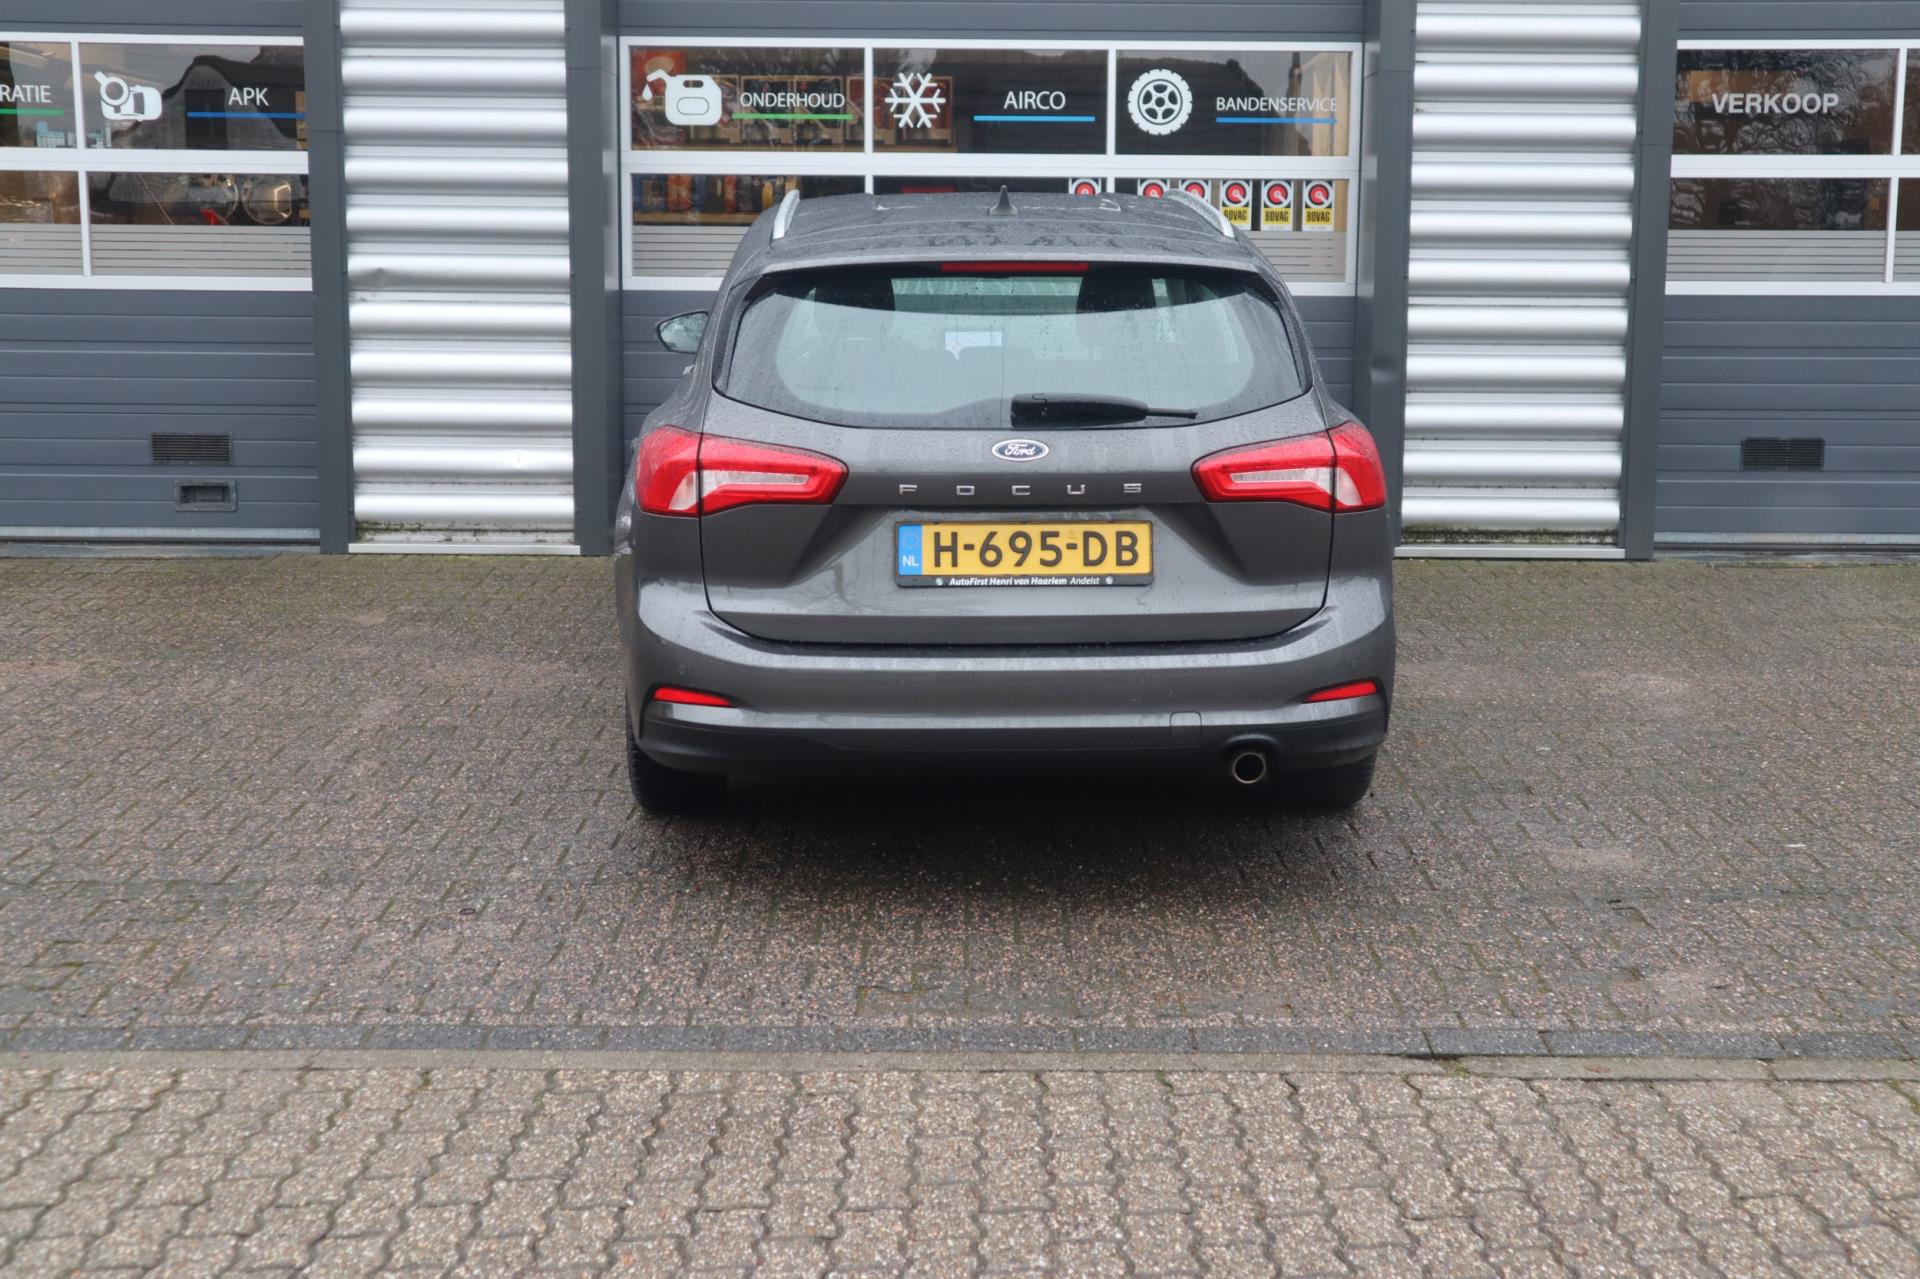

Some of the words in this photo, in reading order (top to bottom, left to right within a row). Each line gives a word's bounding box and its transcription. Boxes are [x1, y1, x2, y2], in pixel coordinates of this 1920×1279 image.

[228, 87, 269, 106] APK
[739, 92, 846, 109] ONDERHOUD
[1003, 91, 1066, 110] AIRCO
[1216, 96, 1337, 112] BANDENSERVICE
[1711, 93, 1839, 114] VERKOOP
[1265, 210, 1289, 222] BOVAG
[1307, 211, 1331, 223] BOVAG
[1003, 443, 1037, 457] Ford
[899, 483, 1142, 496] FOCUS
[933, 530, 1139, 568] H-695-DB
[902, 555, 918, 567] NL
[949, 577, 988, 586] AutoFirst
[989, 577, 1012, 586] Henri
[1031, 577, 1067, 585] Haarlem
[1070, 576, 1100, 585] Andelst
